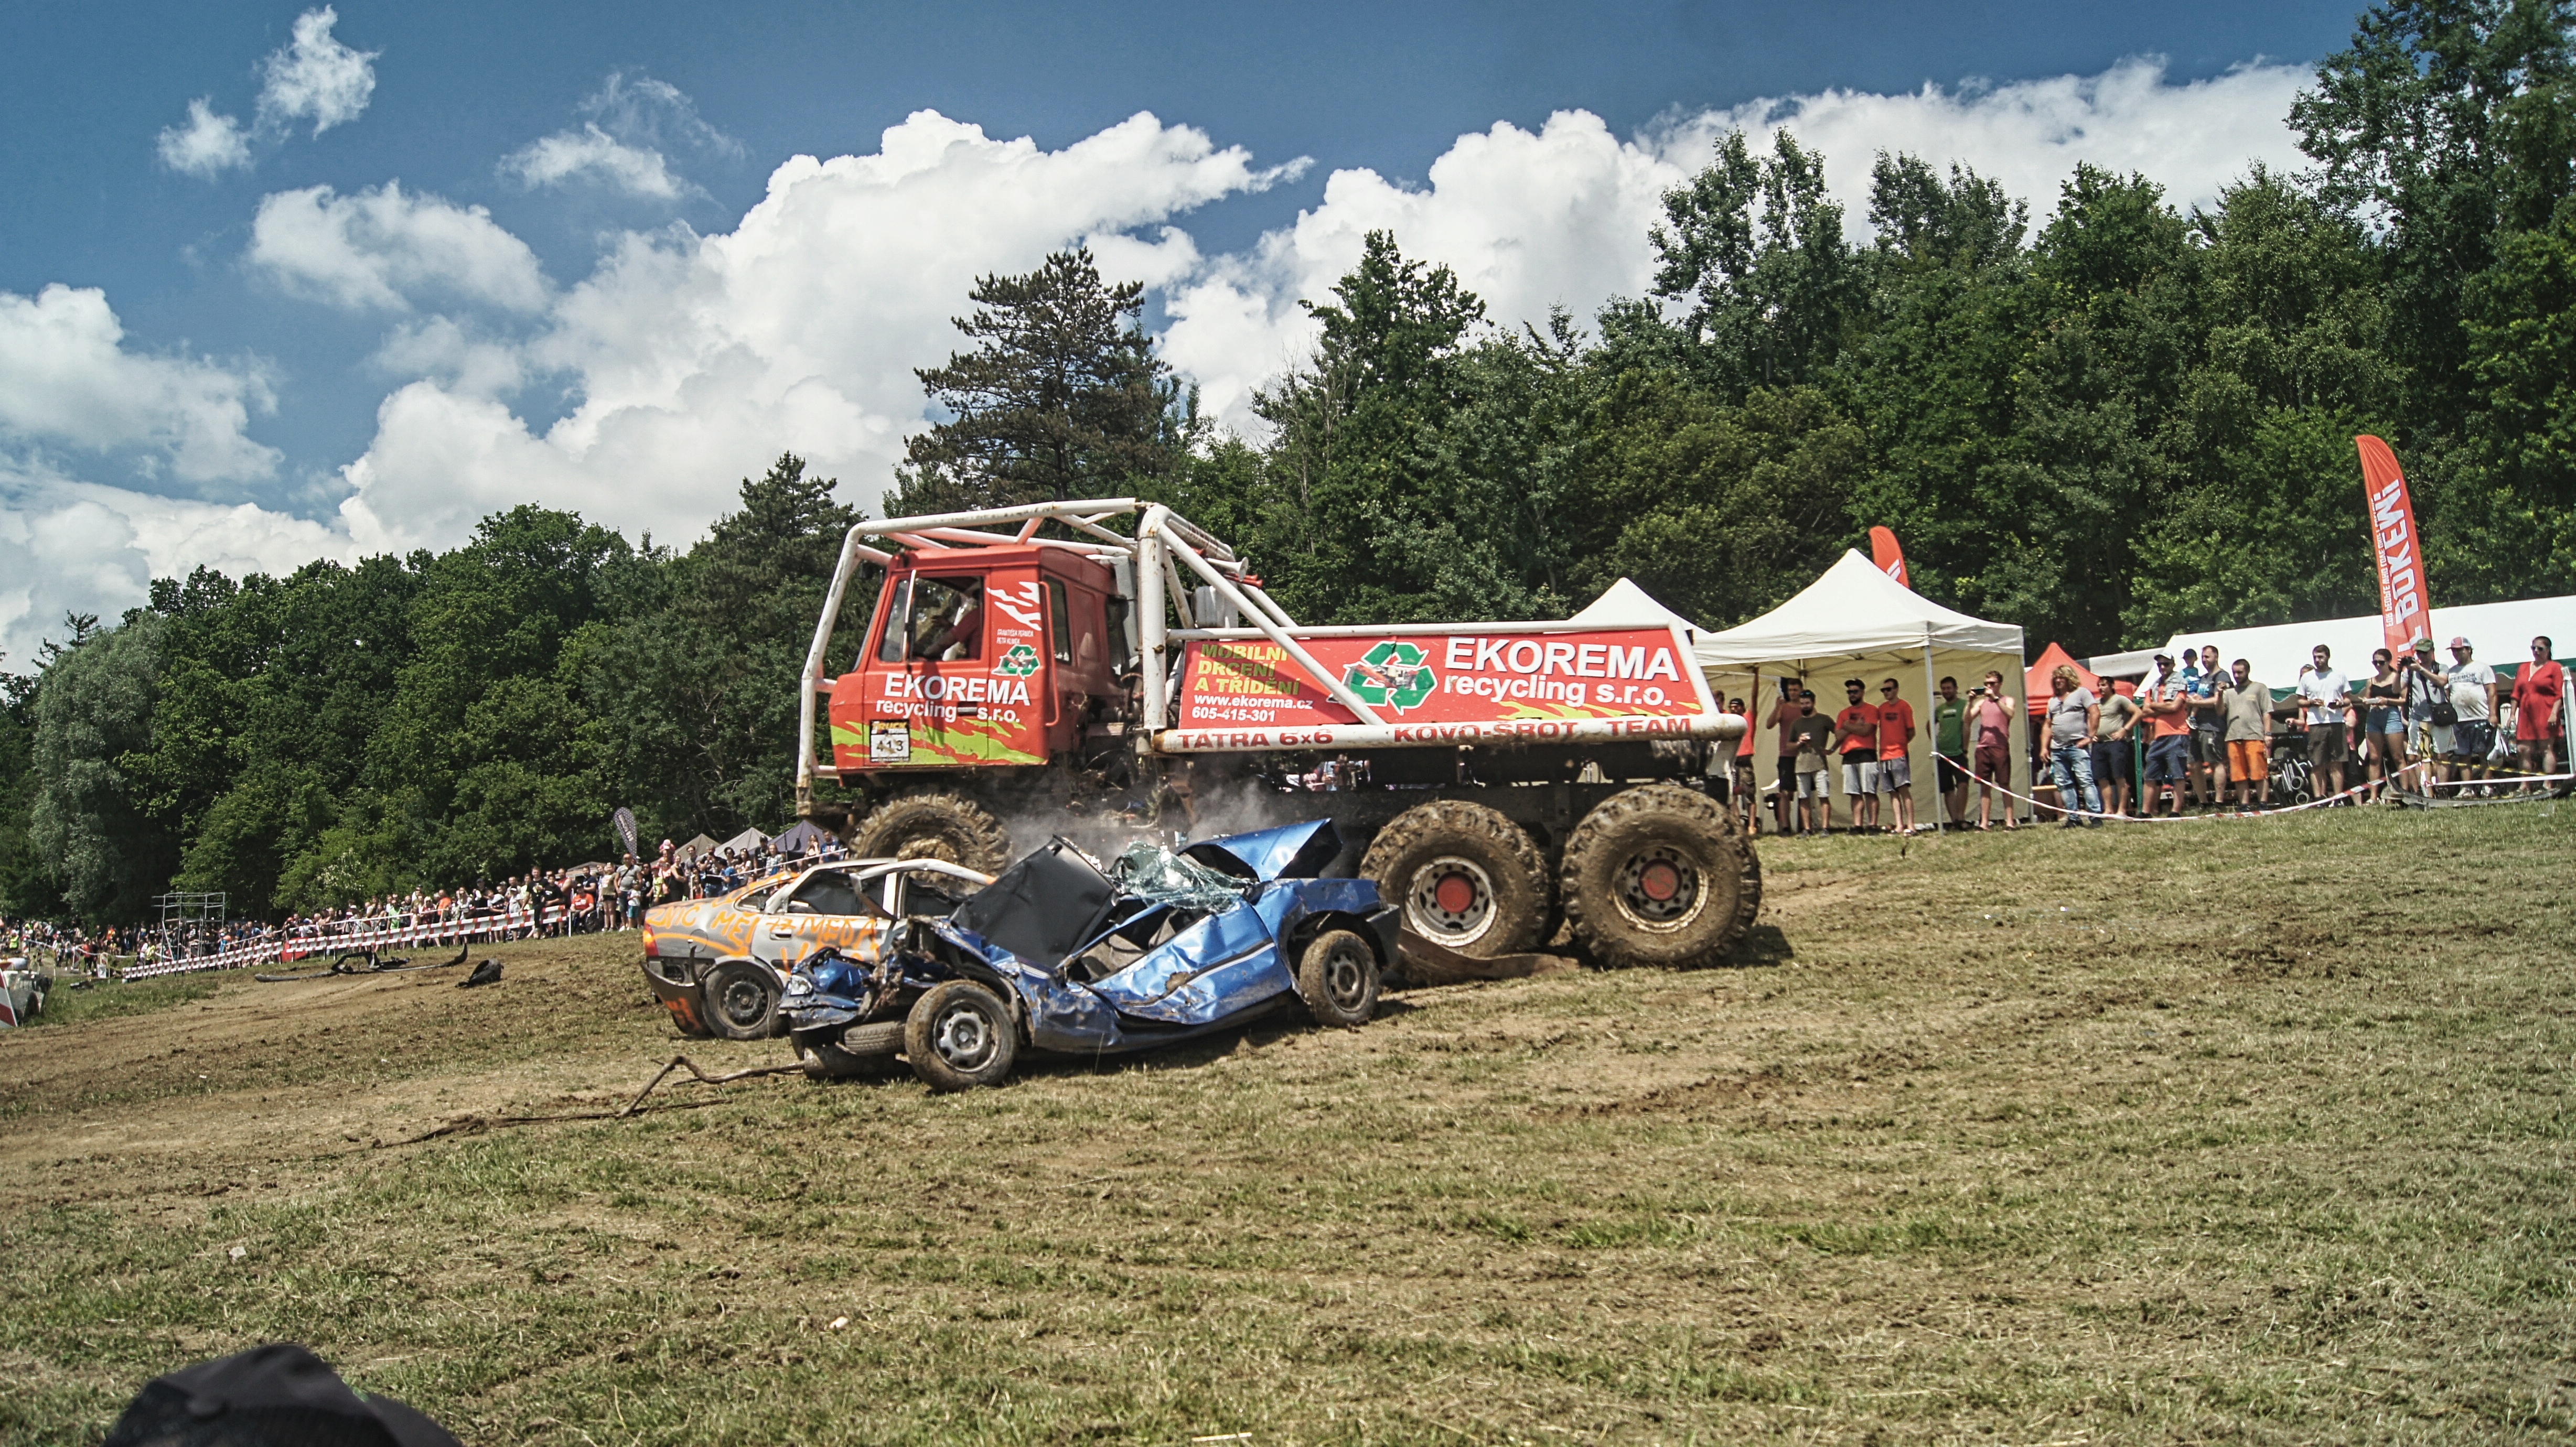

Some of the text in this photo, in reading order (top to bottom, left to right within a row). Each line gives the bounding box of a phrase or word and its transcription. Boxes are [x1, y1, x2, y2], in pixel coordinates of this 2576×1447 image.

[1444, 636, 1679, 682] EKOREMA
[884, 672, 1031, 706] EKOREMA
[1194, 676, 1301, 695] A TŘÍDĚNÍ
[1443, 674, 1672, 708] recycling s.r.o.
[876, 699, 1020, 723] recycling s.r.o.
[1194, 695, 1313, 709] www.ekorema.cz
[1192, 706, 1275, 722] 605-415-301
[1606, 718, 1691, 737] TEAM
[876, 740, 904, 751] 413
[1177, 732, 1270, 749] TATRA
